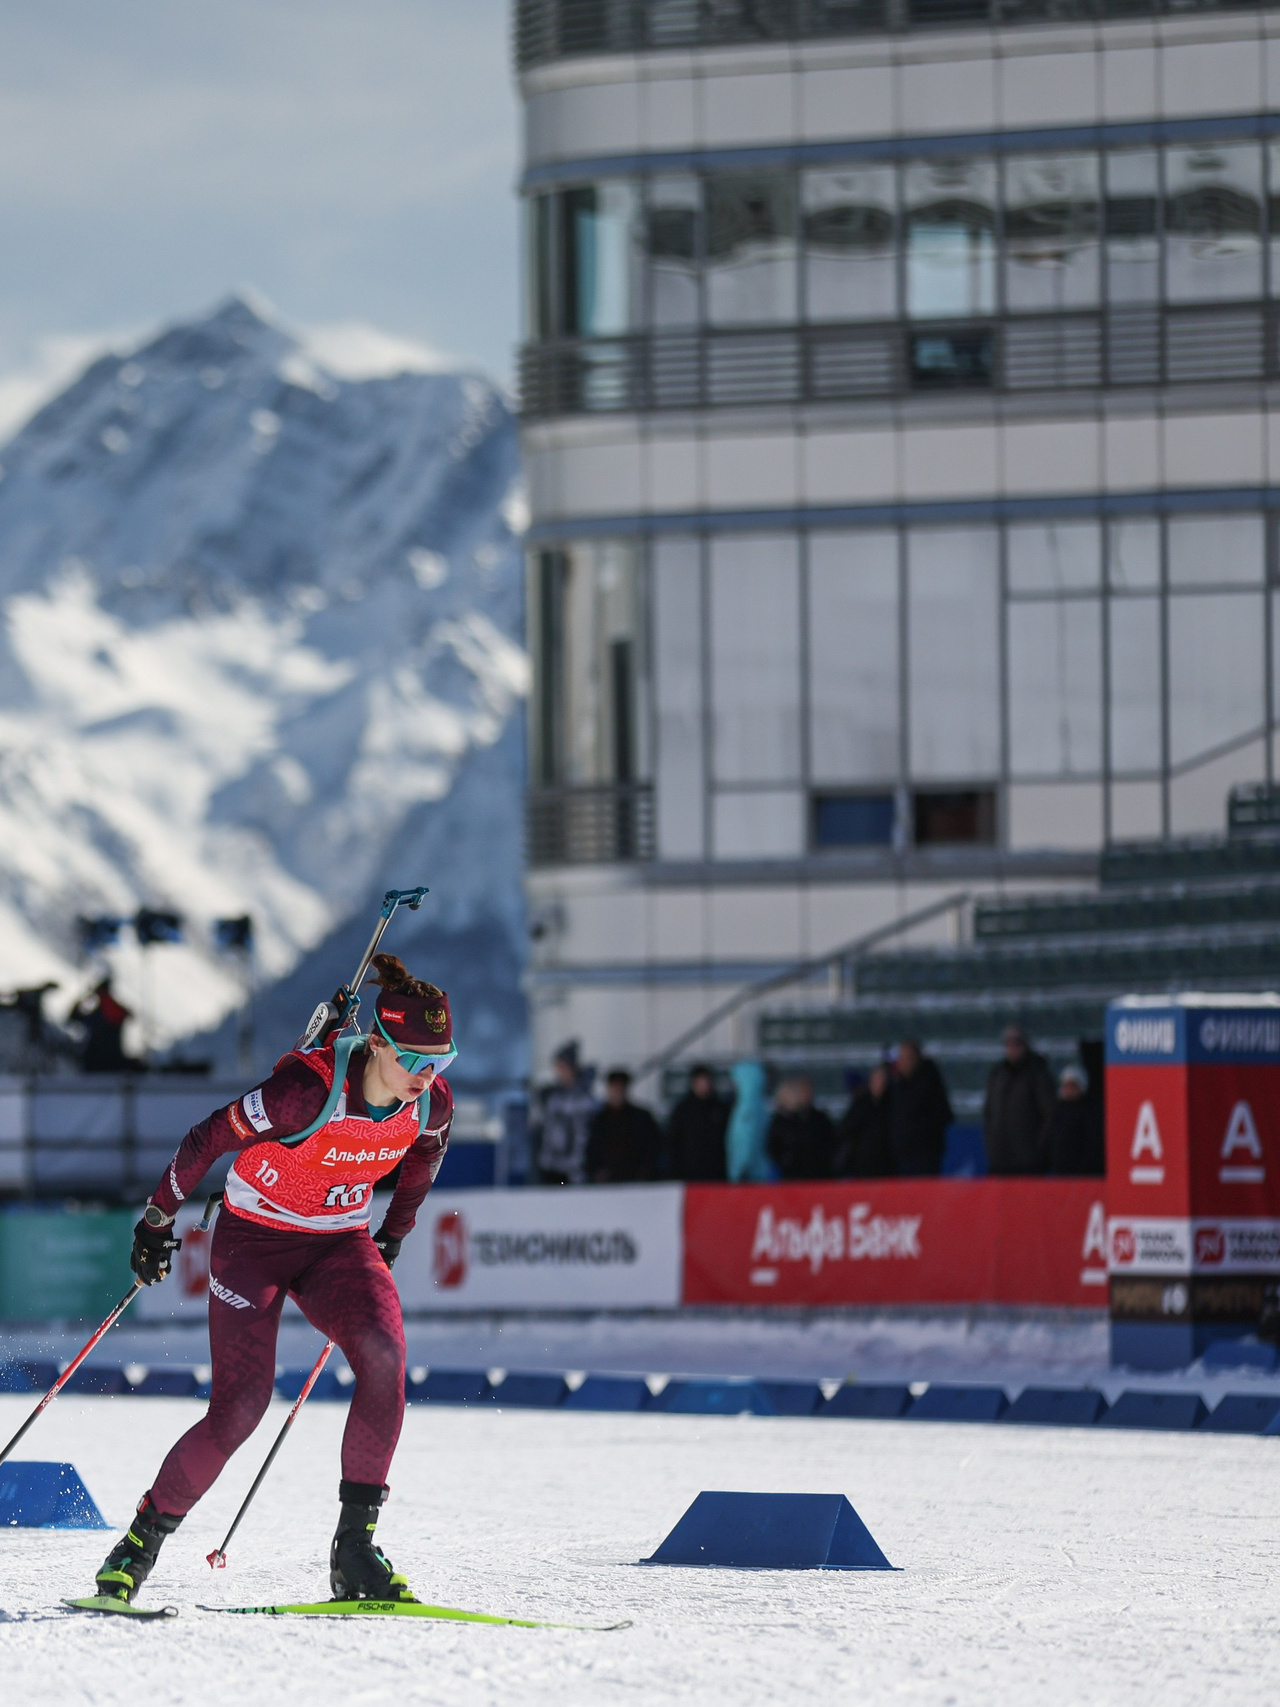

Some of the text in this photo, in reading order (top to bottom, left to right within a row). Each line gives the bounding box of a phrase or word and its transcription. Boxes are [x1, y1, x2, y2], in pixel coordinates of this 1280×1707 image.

[323, 1147, 376, 1165] Альфа
[255, 1160, 279, 1187] 10
[324, 1182, 370, 1207] 10
[752, 1203, 921, 1274] Альфа Банк
[357, 1603, 396, 1611] FISCHER
